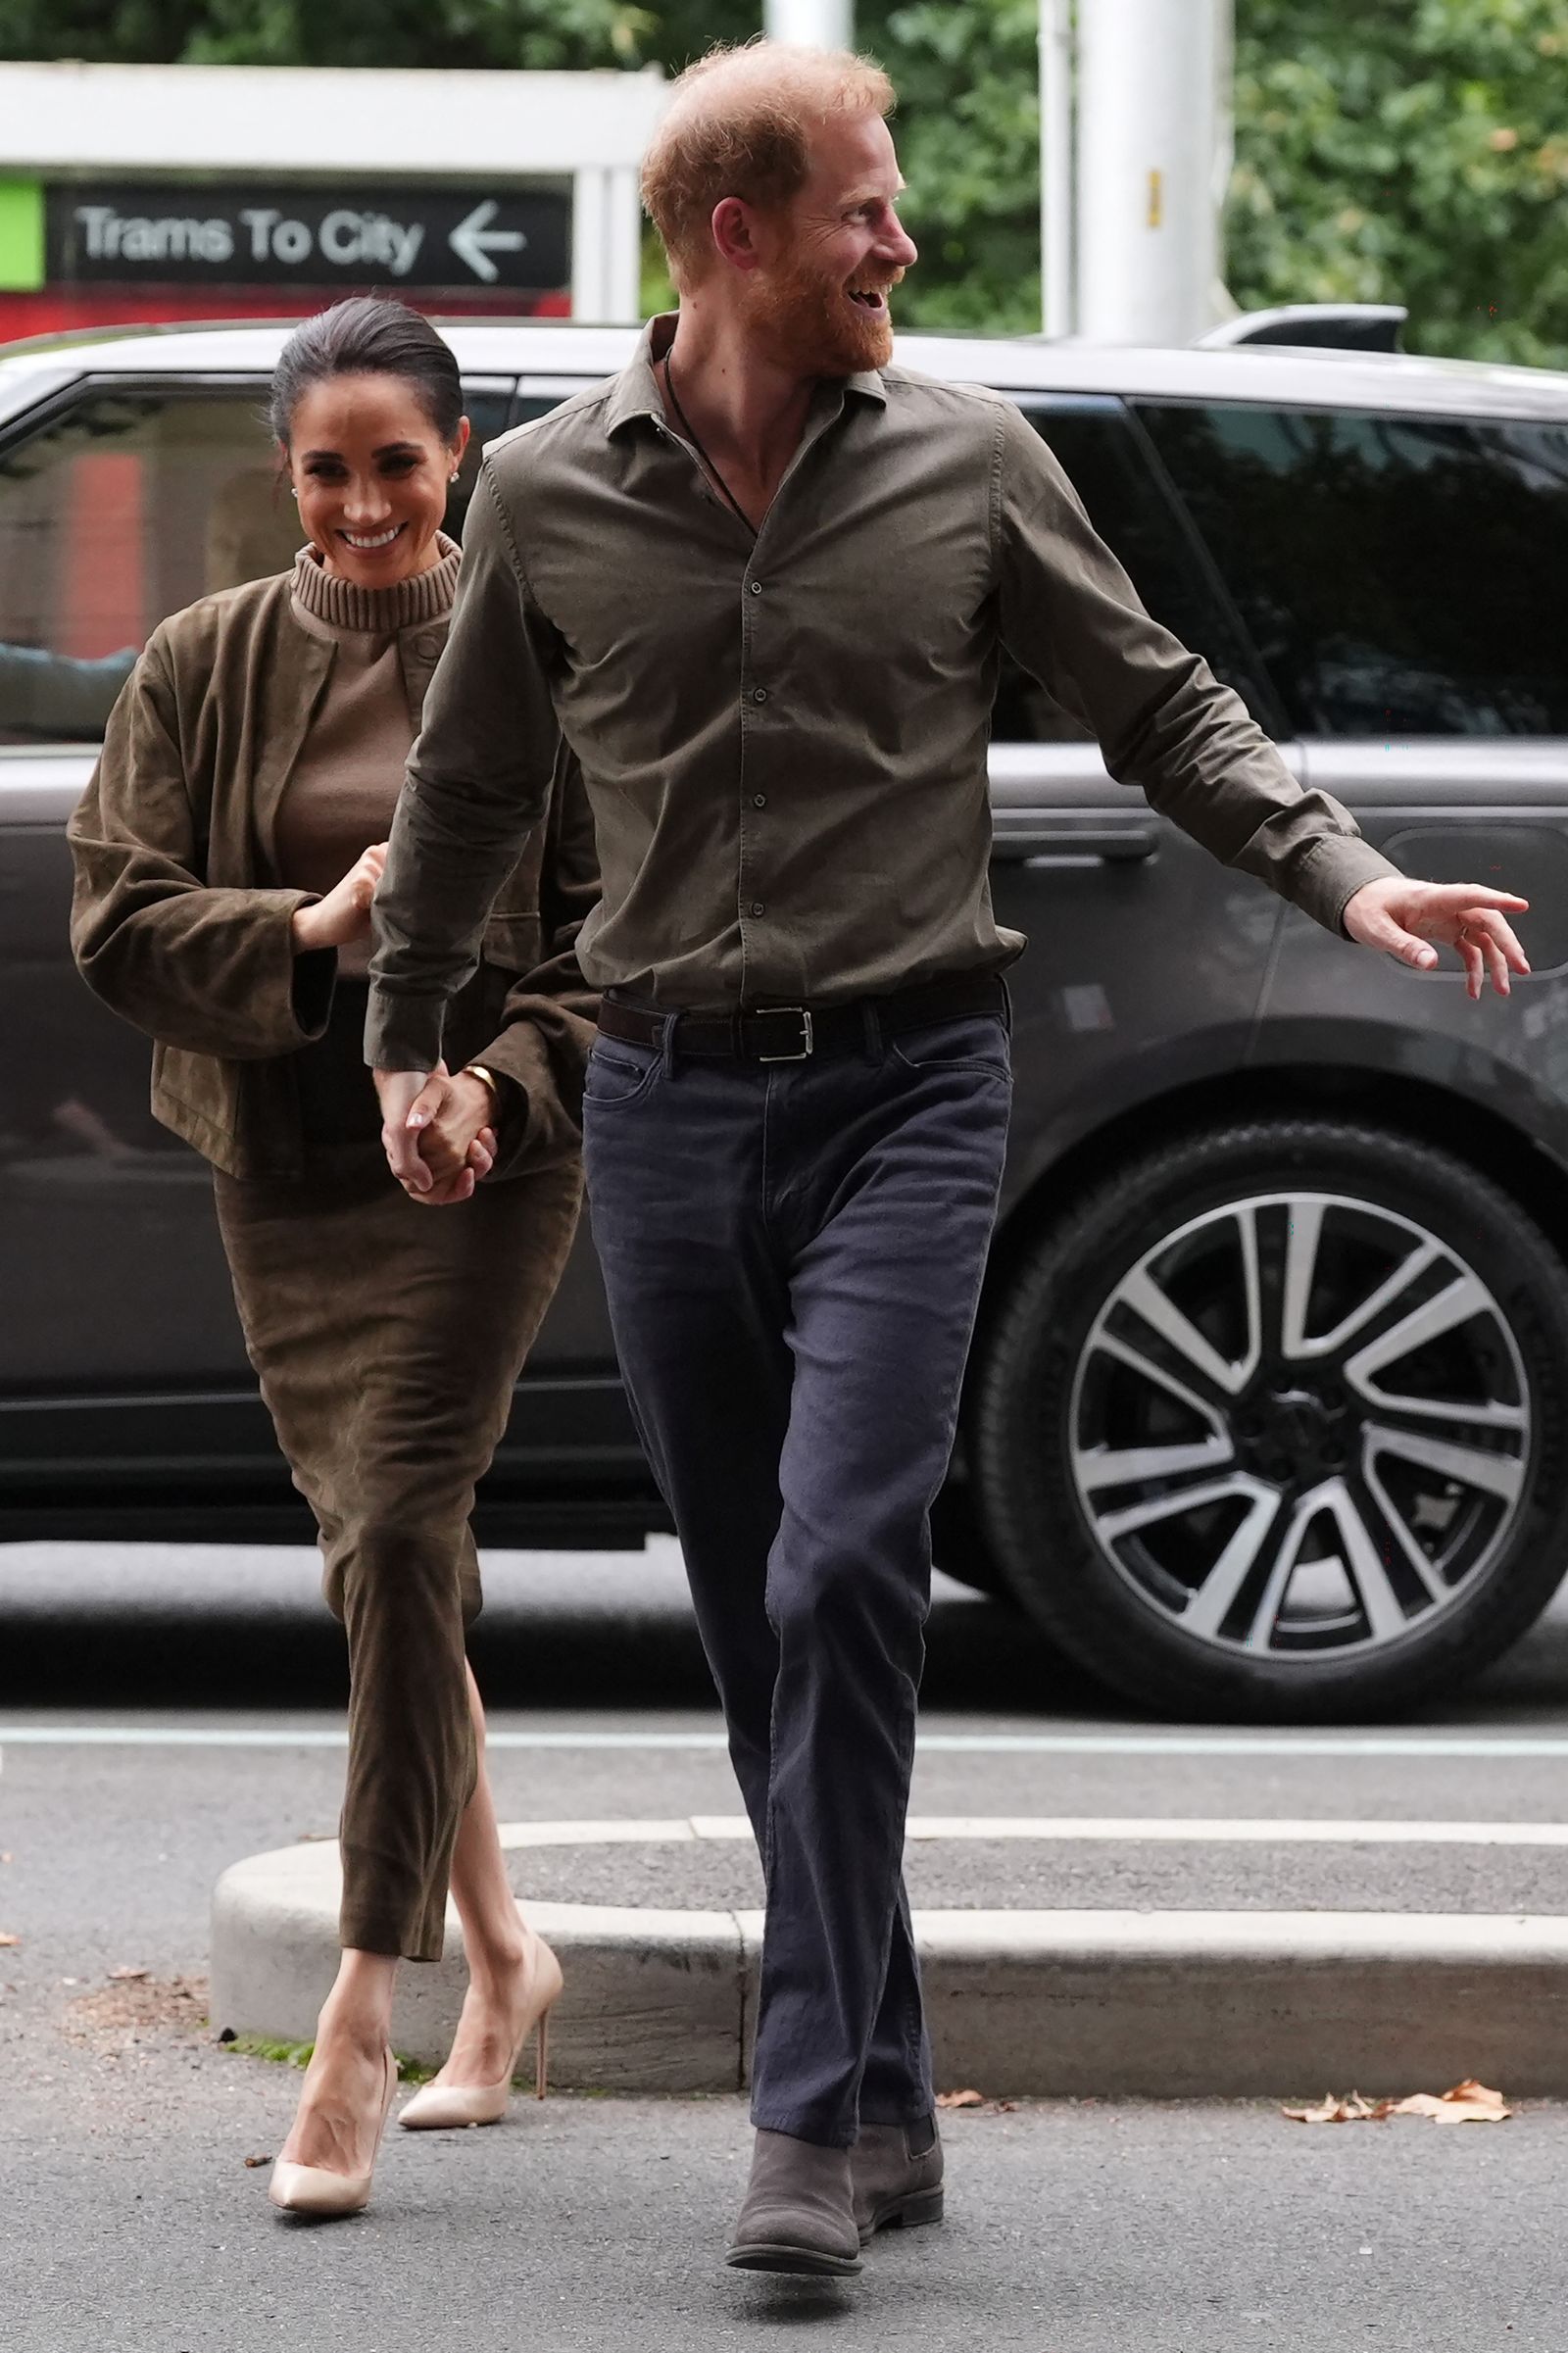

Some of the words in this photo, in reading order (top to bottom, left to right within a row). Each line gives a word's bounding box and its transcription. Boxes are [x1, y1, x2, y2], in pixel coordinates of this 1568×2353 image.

[75, 206, 233, 262] Trams
[241, 208, 312, 263] To
[319, 210, 423, 276] City
